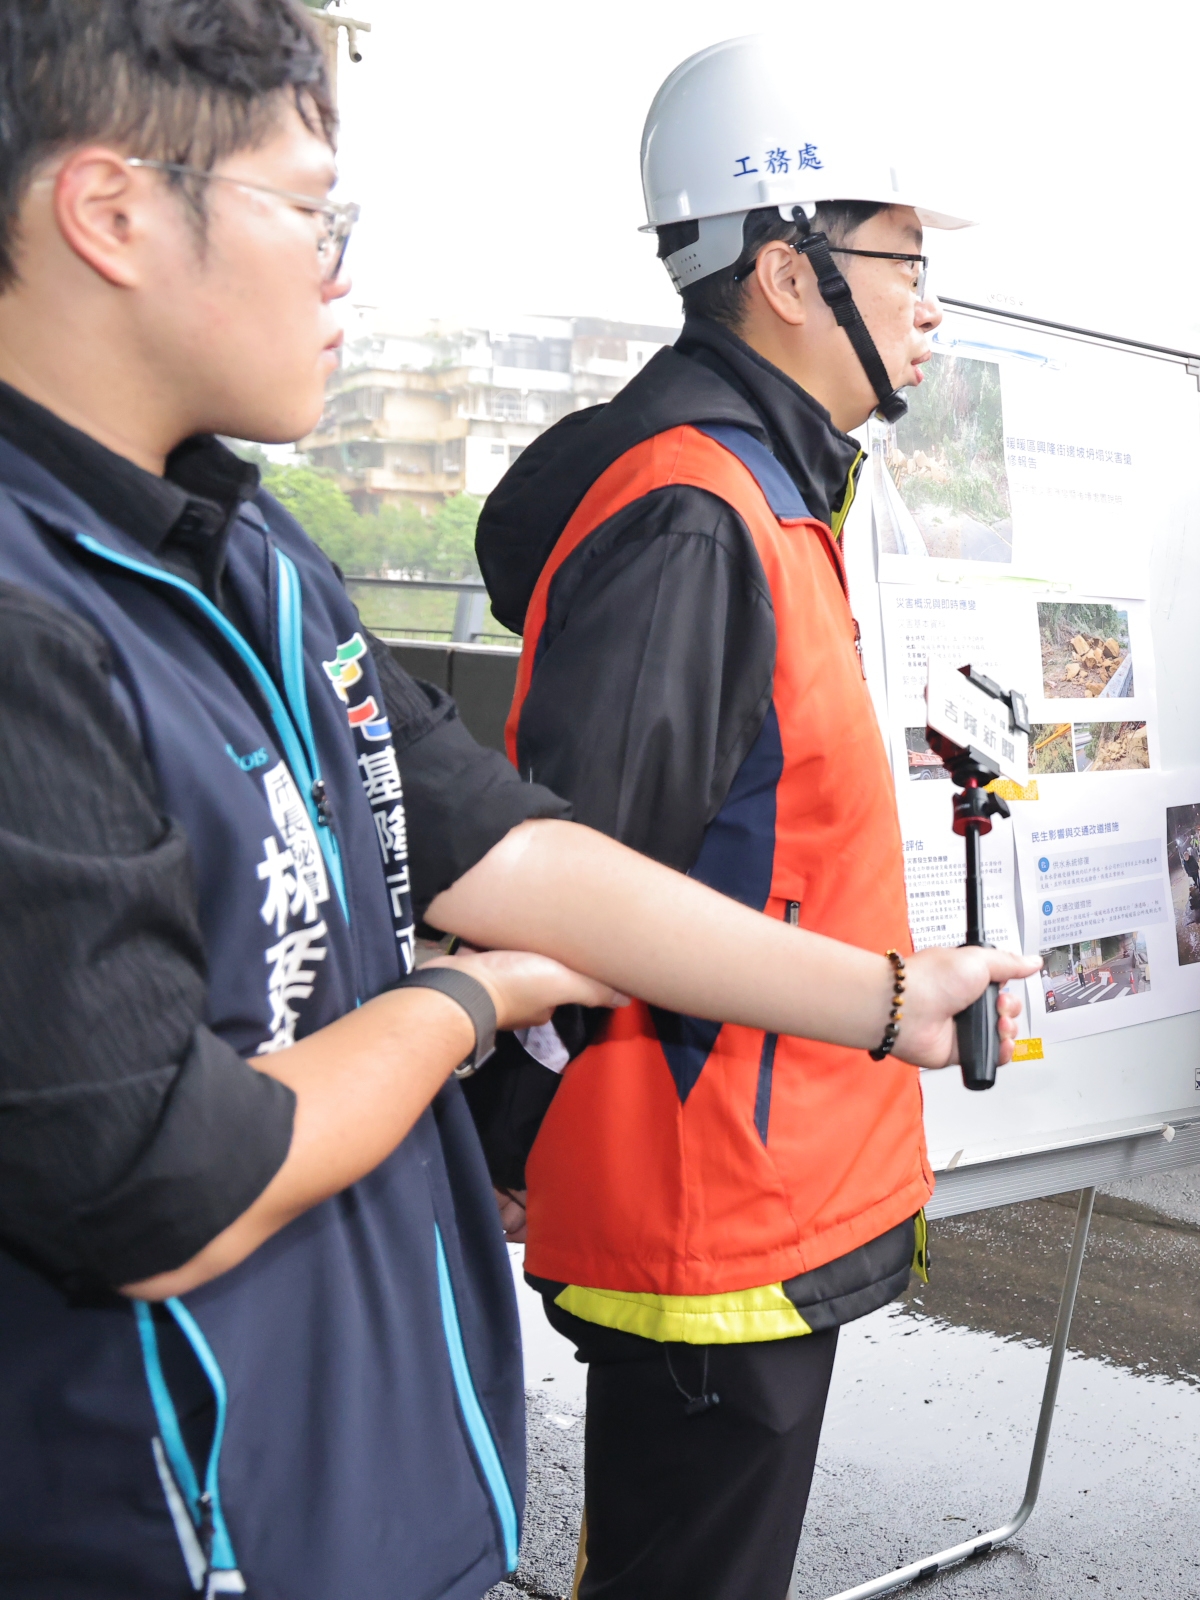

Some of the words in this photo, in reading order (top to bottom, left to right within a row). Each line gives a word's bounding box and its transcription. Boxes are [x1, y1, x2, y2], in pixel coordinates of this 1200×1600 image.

[733, 143, 824, 177] 工務處
[1007, 455, 1037, 469] 修報告
[896, 597, 976, 611] 災害概況與即時應變
[1031, 821, 1120, 843] 民生影響與交通改道措施
[1055, 899, 1092, 913] 交通改道措施
